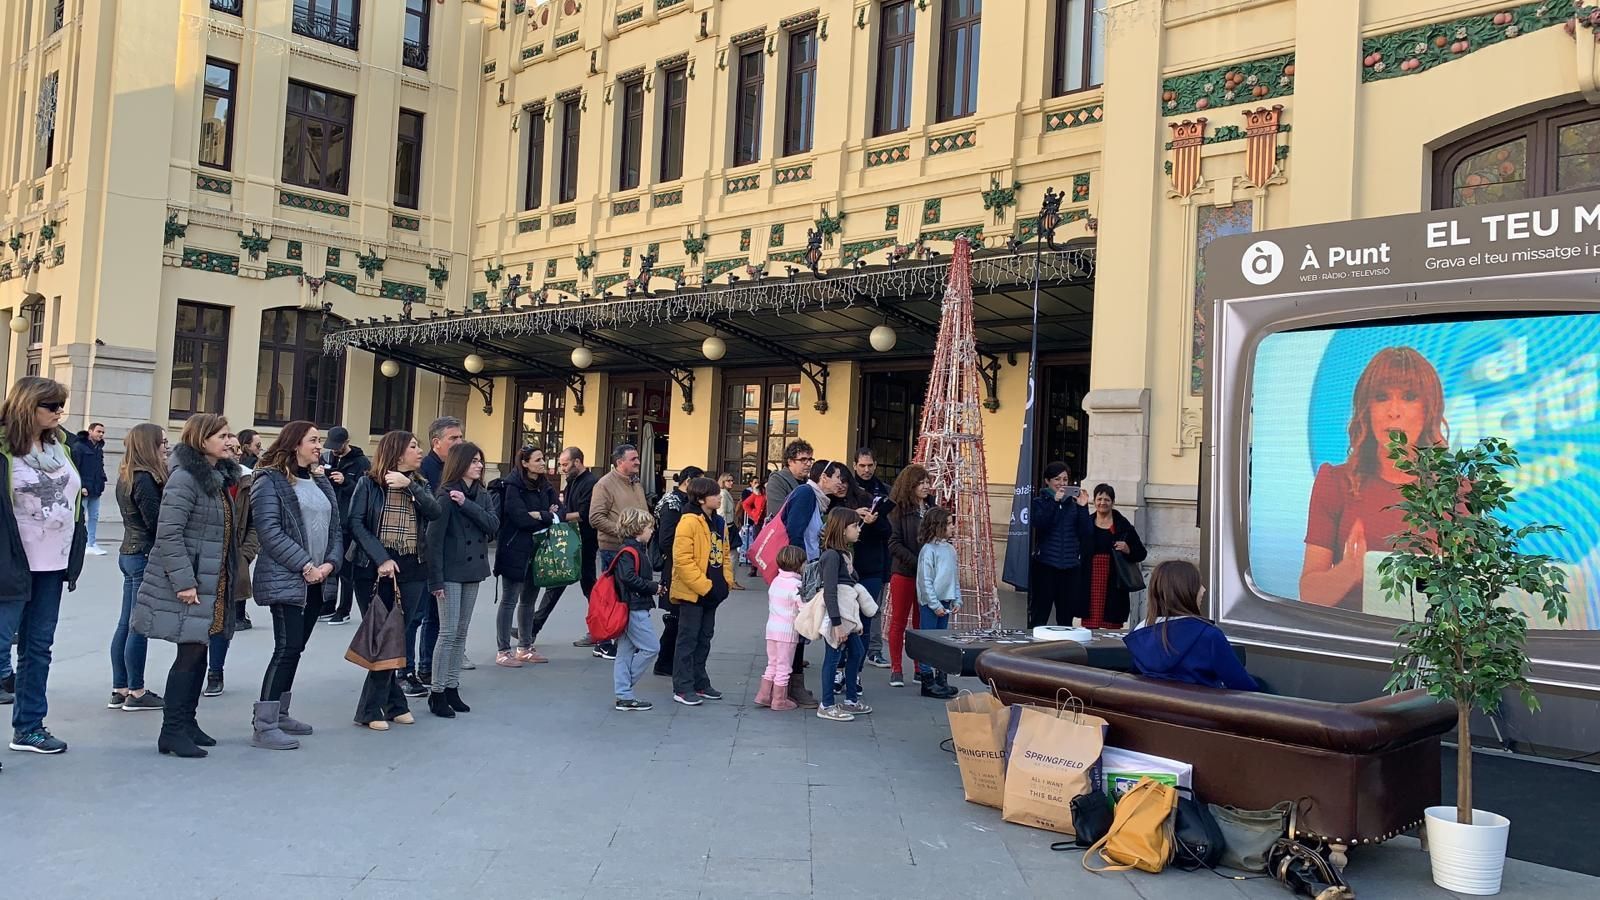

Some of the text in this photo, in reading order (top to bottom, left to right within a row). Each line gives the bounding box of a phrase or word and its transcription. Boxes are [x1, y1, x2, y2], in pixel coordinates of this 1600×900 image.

[1427, 221, 1470, 248] EL
[1481, 208, 1559, 242] TEU
[1300, 242, 1391, 271] À Punt
[1425, 256, 1466, 270] Grava
[1469, 252, 1481, 265] el
[1484, 251, 1508, 264] teu
[1512, 244, 1581, 262] missatge
[1584, 242, 1589, 255] i
[1299, 273, 1317, 283] WEB
[956, 745, 1006, 759] PRINGFIELD
[1024, 750, 1084, 769] SPRINGFIELD
[1047, 794, 1063, 803] BAG
